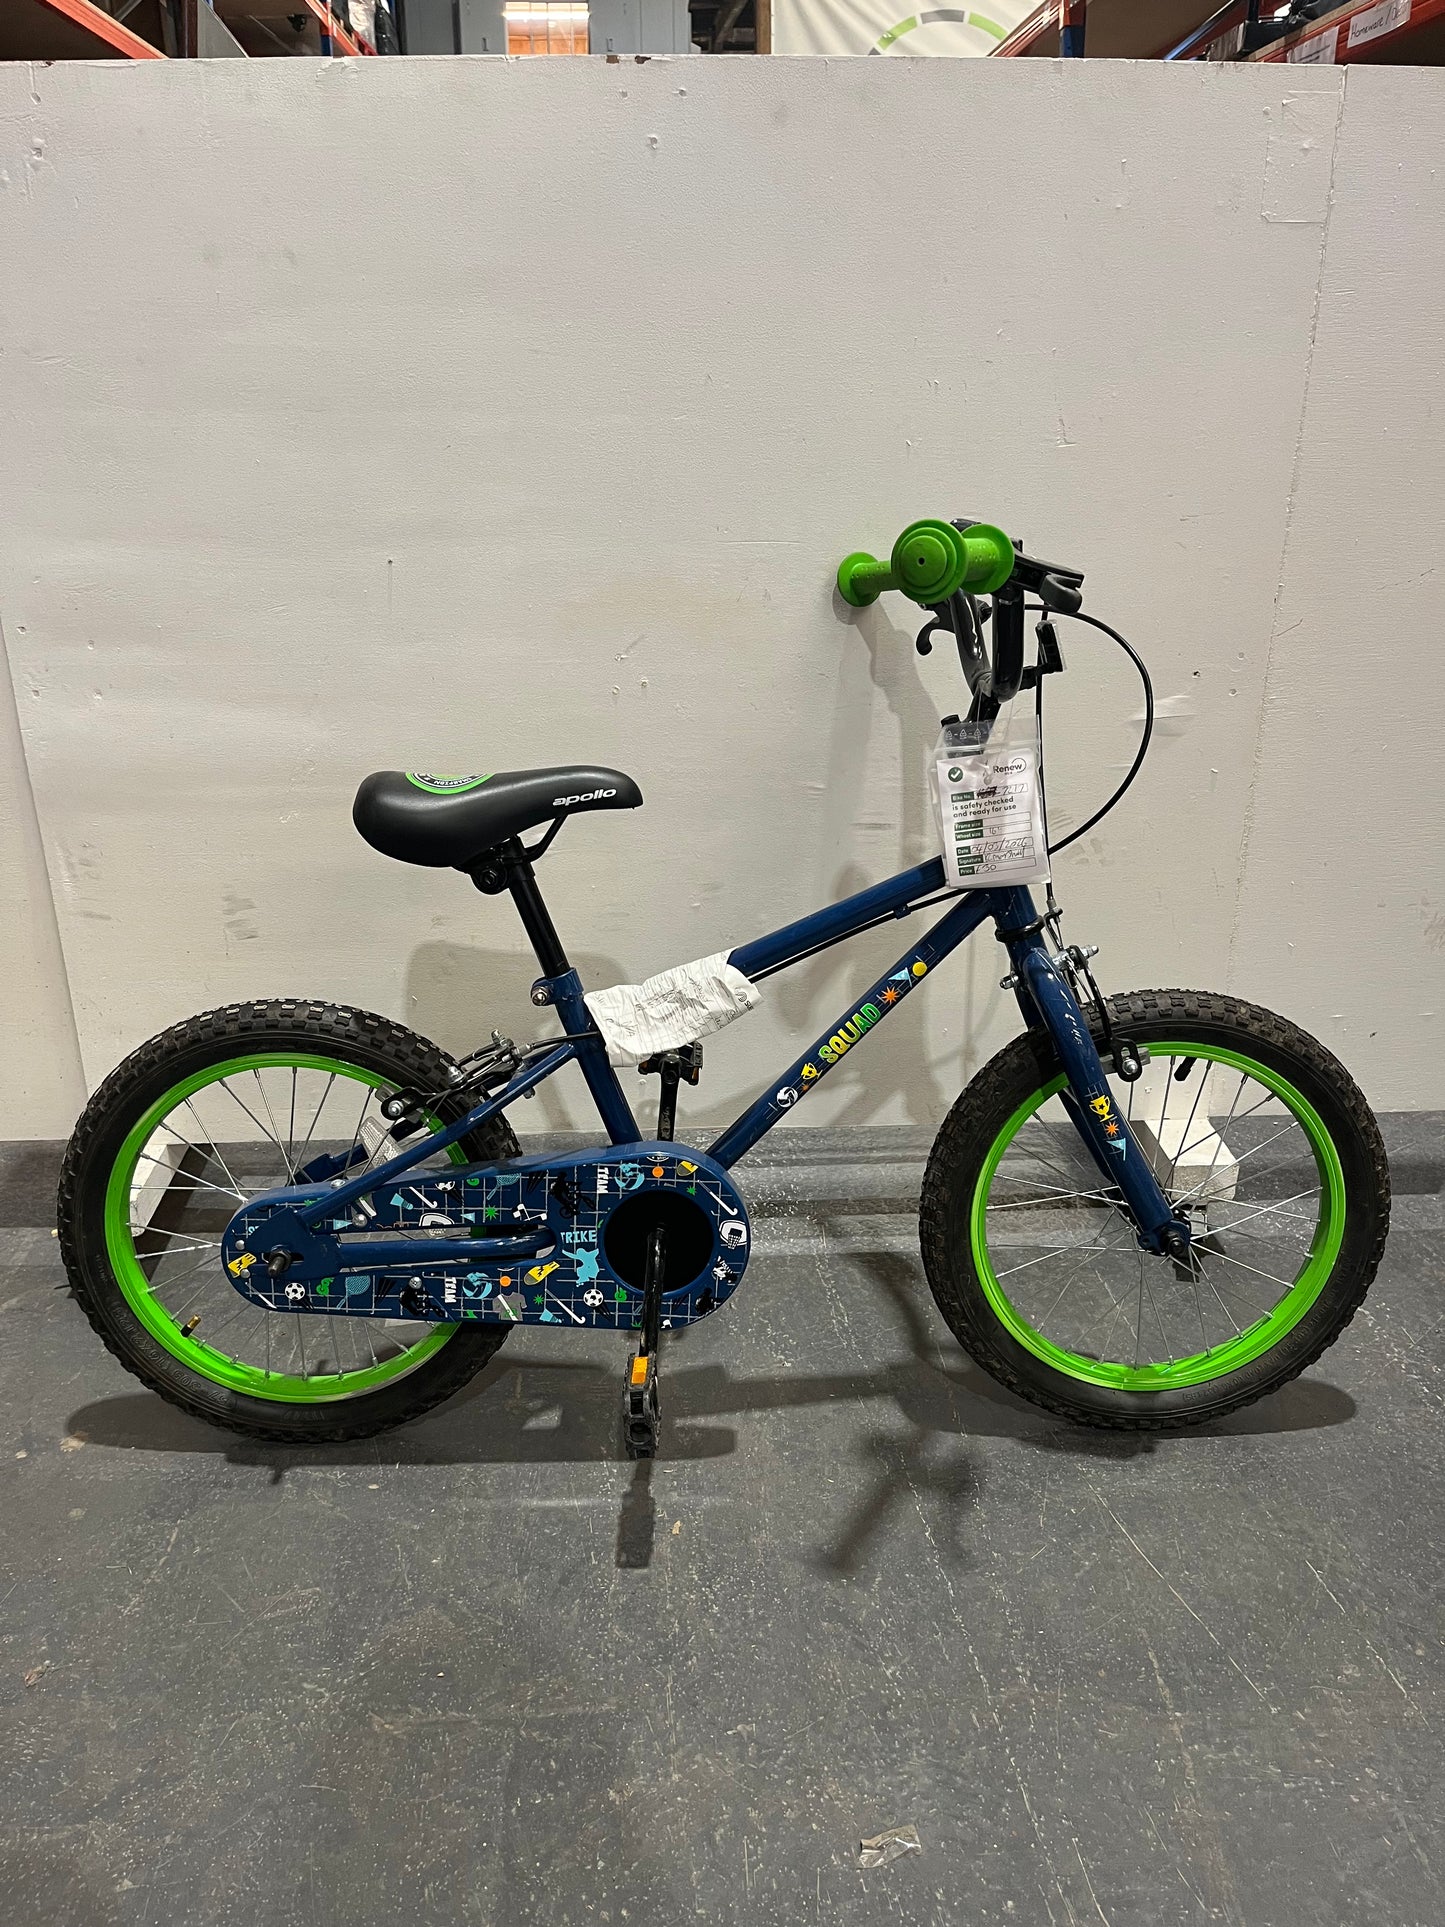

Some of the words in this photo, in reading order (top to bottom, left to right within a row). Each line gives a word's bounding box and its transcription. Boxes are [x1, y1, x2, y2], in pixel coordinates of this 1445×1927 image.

[993, 764, 1022, 774] Renew
[552, 788, 617, 806] apollo
[960, 801, 982, 810] safety
[984, 796, 1014, 807] checked
[969, 807, 990, 816] ready
[991, 805, 1002, 813] for
[958, 857, 981, 865] Signature
[818, 1002, 882, 1064] SQUAD
[597, 1167, 609, 1194] TEAM
[444, 1276, 457, 1303] TEAM
